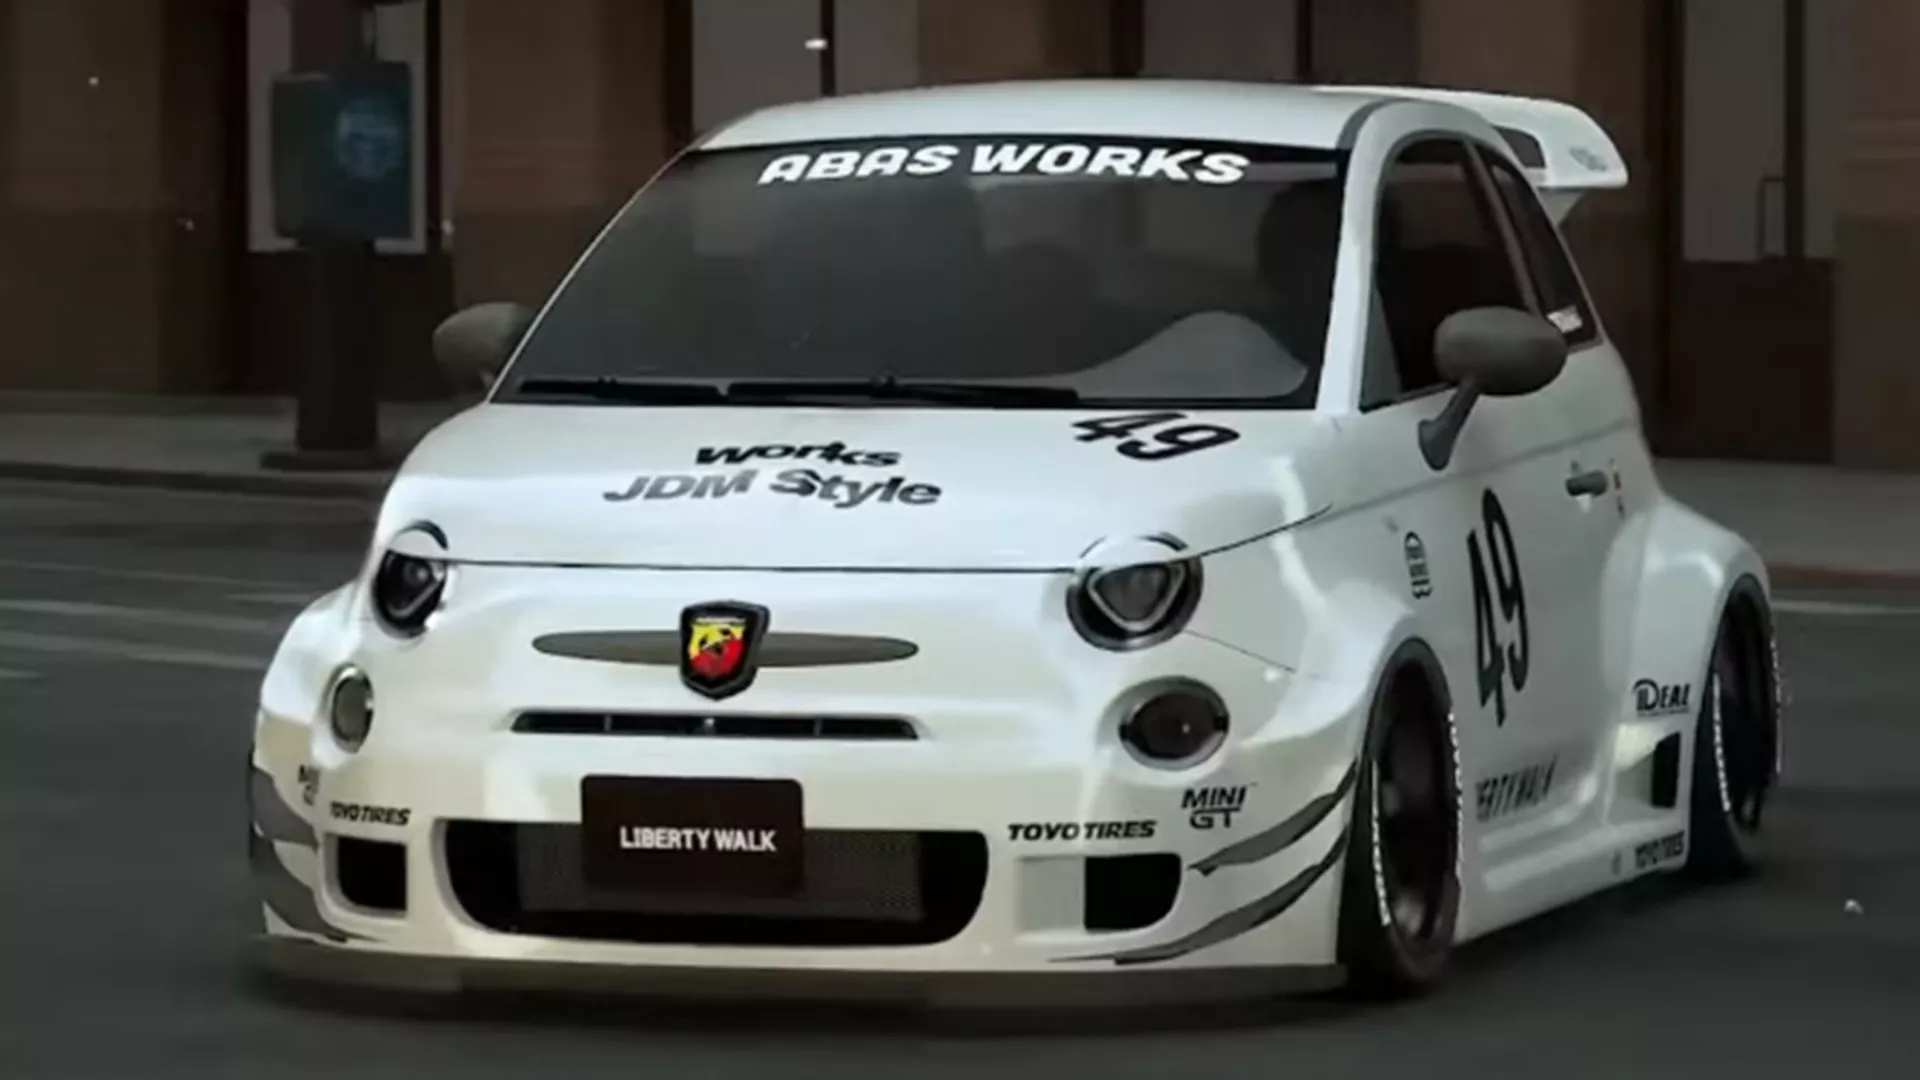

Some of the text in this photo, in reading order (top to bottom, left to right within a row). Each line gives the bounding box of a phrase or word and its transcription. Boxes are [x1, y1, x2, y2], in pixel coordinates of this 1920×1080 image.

[759, 144, 1250, 185] ABAS WORKS
[1072, 411, 1241, 461] 49
[603, 469, 942, 508] JDM Style
[1467, 487, 1529, 728] 49
[1182, 786, 1247, 809] MINI
[1008, 820, 1157, 840] TOYO TIRES
[1189, 808, 1240, 829] GT
[619, 826, 777, 851] LIBERTY WALK
